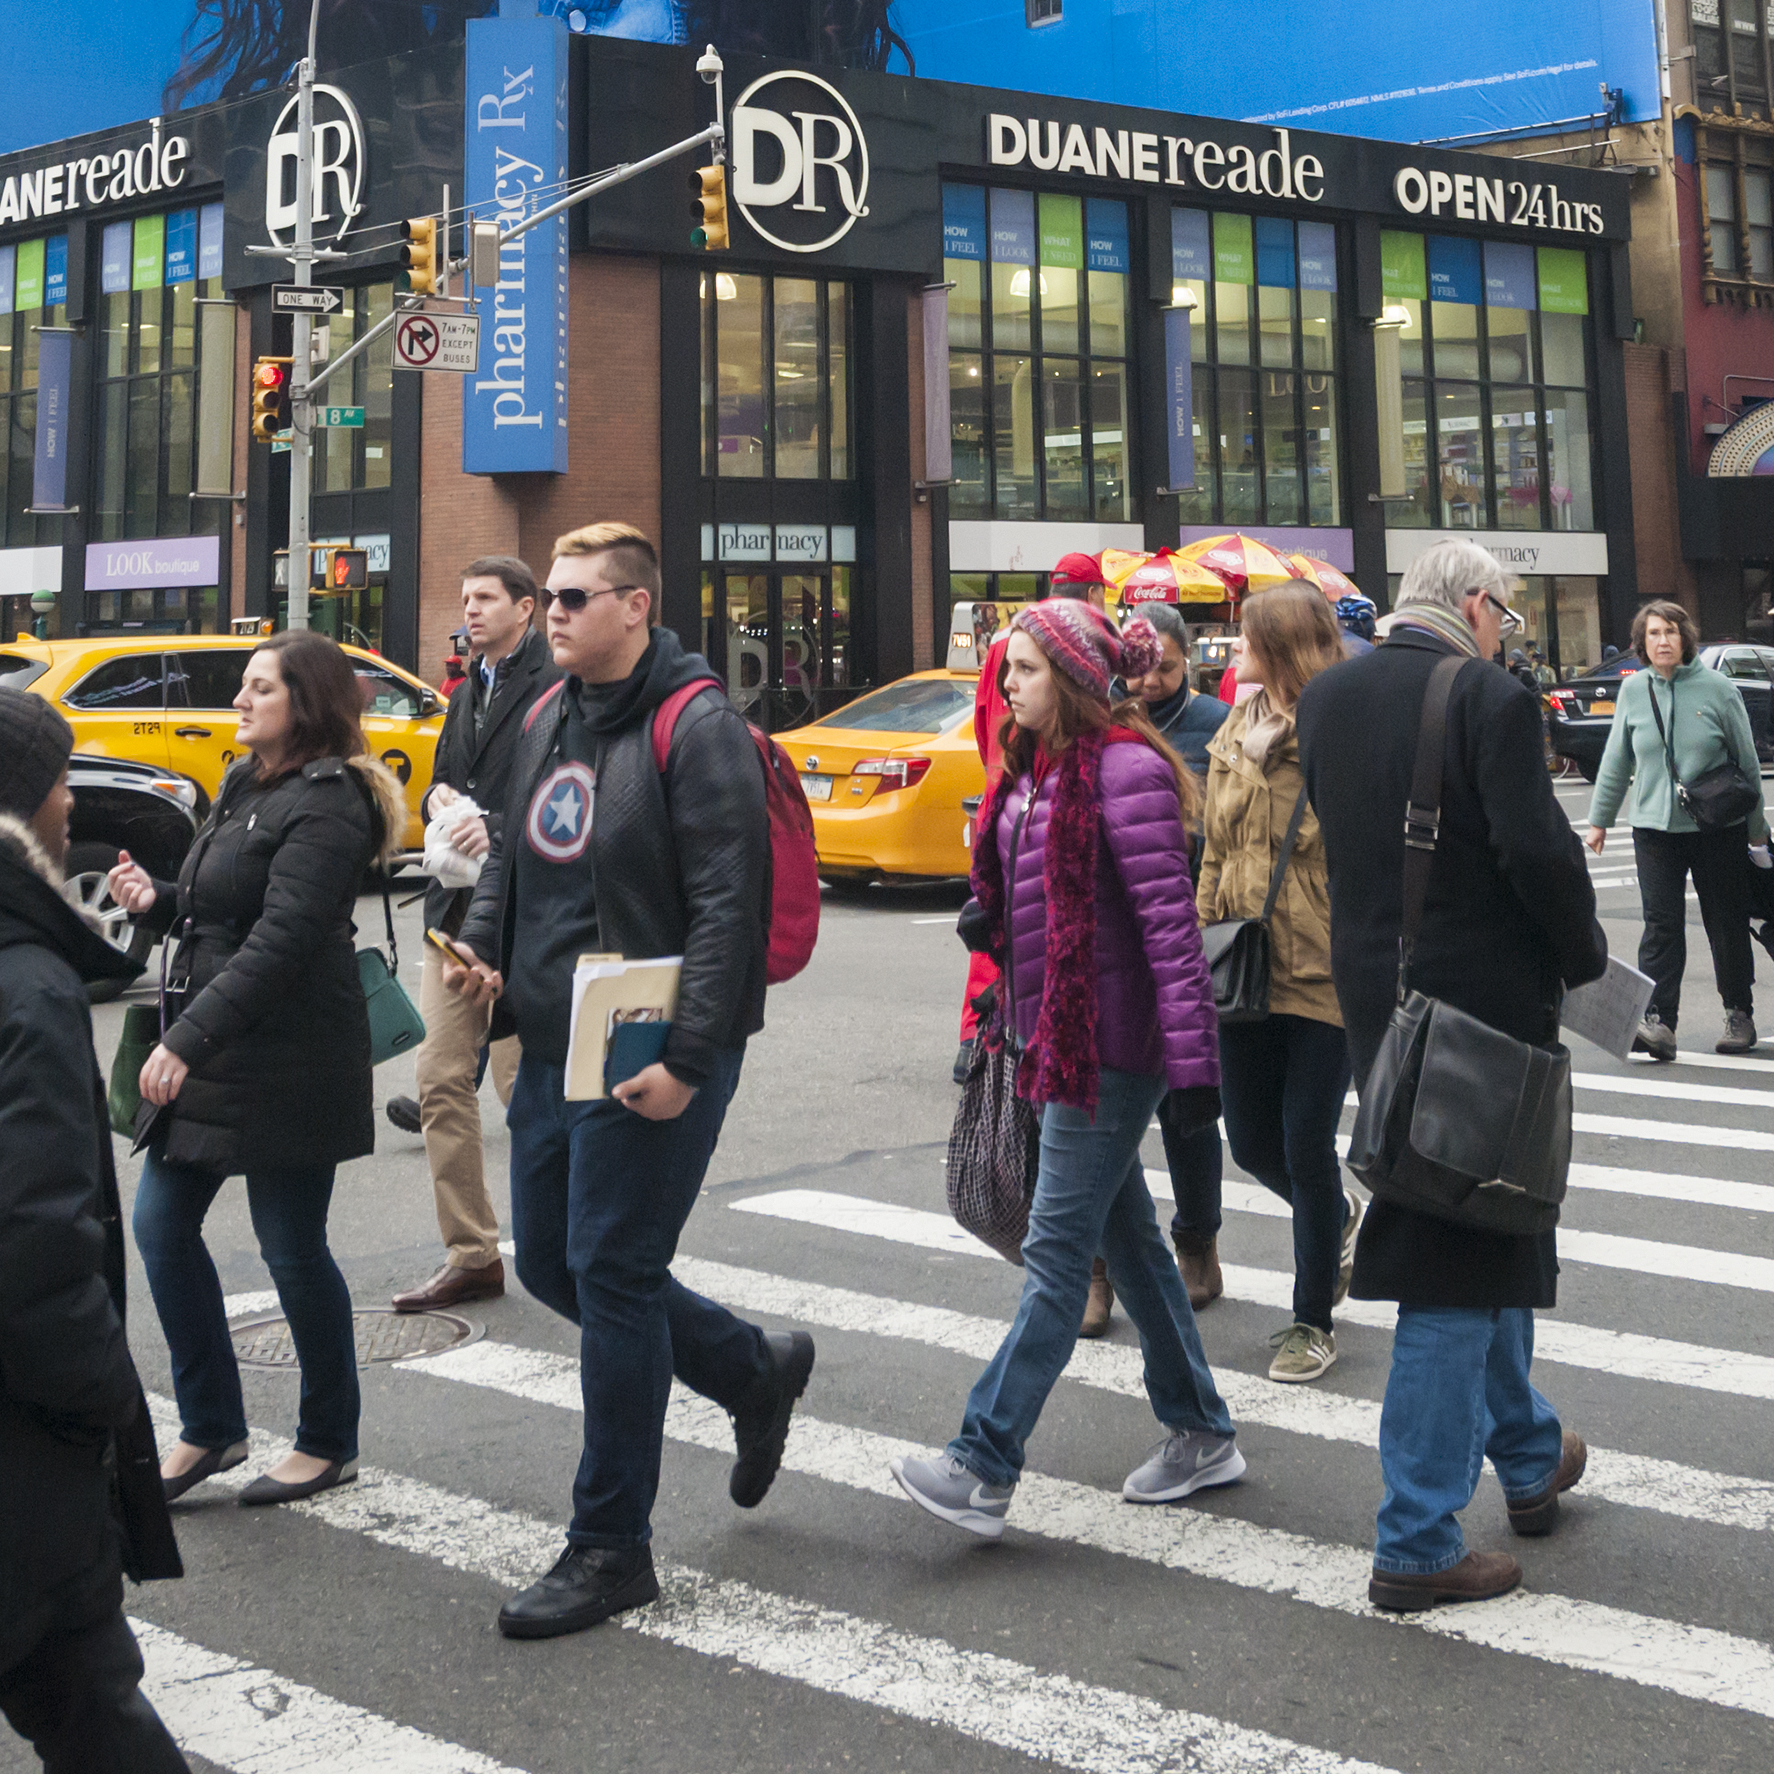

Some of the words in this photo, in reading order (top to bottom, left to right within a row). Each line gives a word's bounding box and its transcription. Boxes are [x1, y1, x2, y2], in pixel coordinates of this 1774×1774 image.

[478, 65, 534, 132] Rx
[731, 104, 870, 218] DR
[1395, 166, 1507, 223] OPEN
[1509, 178, 1606, 236] 24hrs
[945, 226, 968, 237] HOW
[994, 230, 1017, 242] HOW
[951, 240, 979, 254] FEEL
[1090, 240, 1113, 251] HOW
[1098, 254, 1123, 267] FEEL
[475, 146, 545, 431] pharmacy
[283, 293, 303, 305] ONE
[312, 295, 333, 307] WAY
[442, 322, 475, 335] 7AM-7PM
[442, 339, 473, 350] EXCEPT
[443, 354, 471, 364] BUSES
[330, 409, 341, 425] 8
[106, 551, 154, 576] LOOK
[154, 557, 199, 576] boutique
